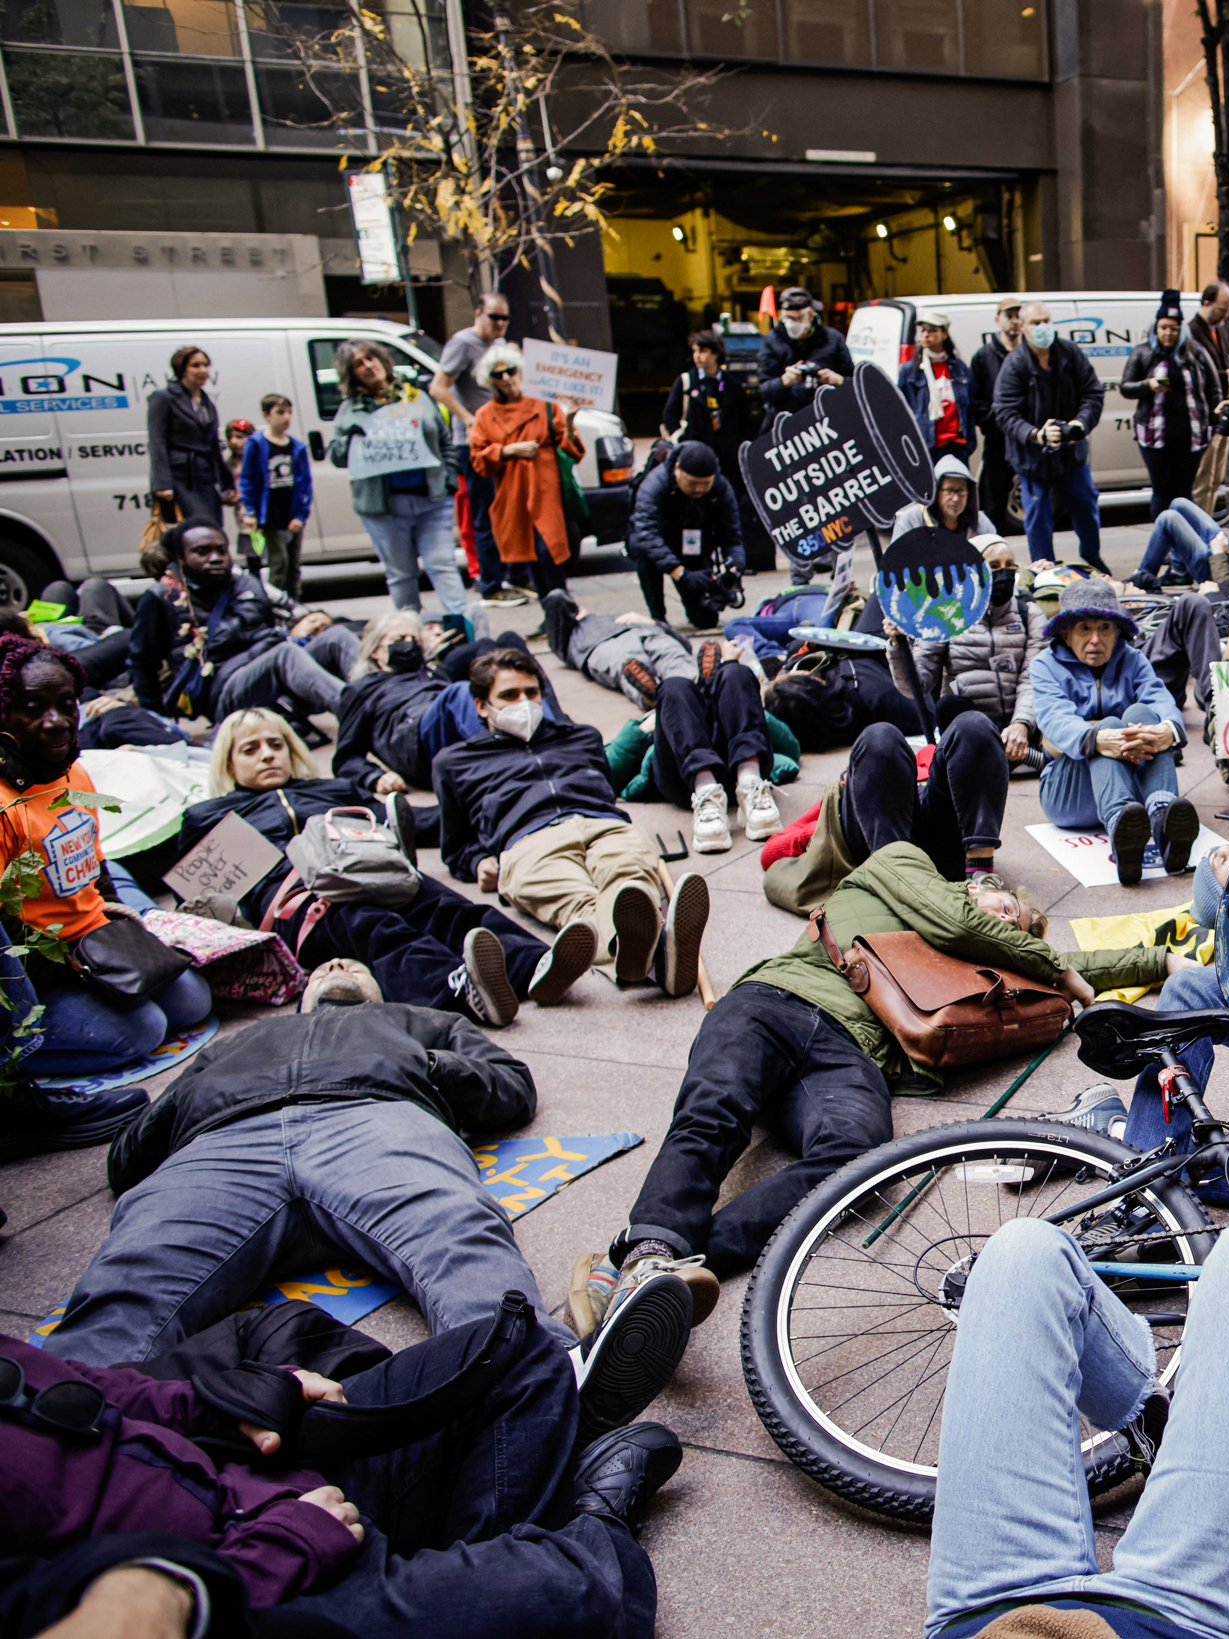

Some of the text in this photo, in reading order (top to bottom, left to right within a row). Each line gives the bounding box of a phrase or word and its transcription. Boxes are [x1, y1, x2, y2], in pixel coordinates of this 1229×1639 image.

[132, 246, 287, 264] STREET
[535, 362, 604, 383] EMERGENCY
[572, 356, 591, 368] AN
[563, 381, 586, 393] LIKE
[16, 397, 119, 413] SERVICES
[79, 443, 147, 459] SERVIC
[764, 417, 838, 472] THINK
[764, 439, 864, 511] OUTSIDE
[771, 465, 893, 545] THE BARREL
[797, 516, 853, 557] 350NYC
[61, 836, 82, 857] NEW
[174, 838, 221, 883] People
[198, 849, 227, 887] over
